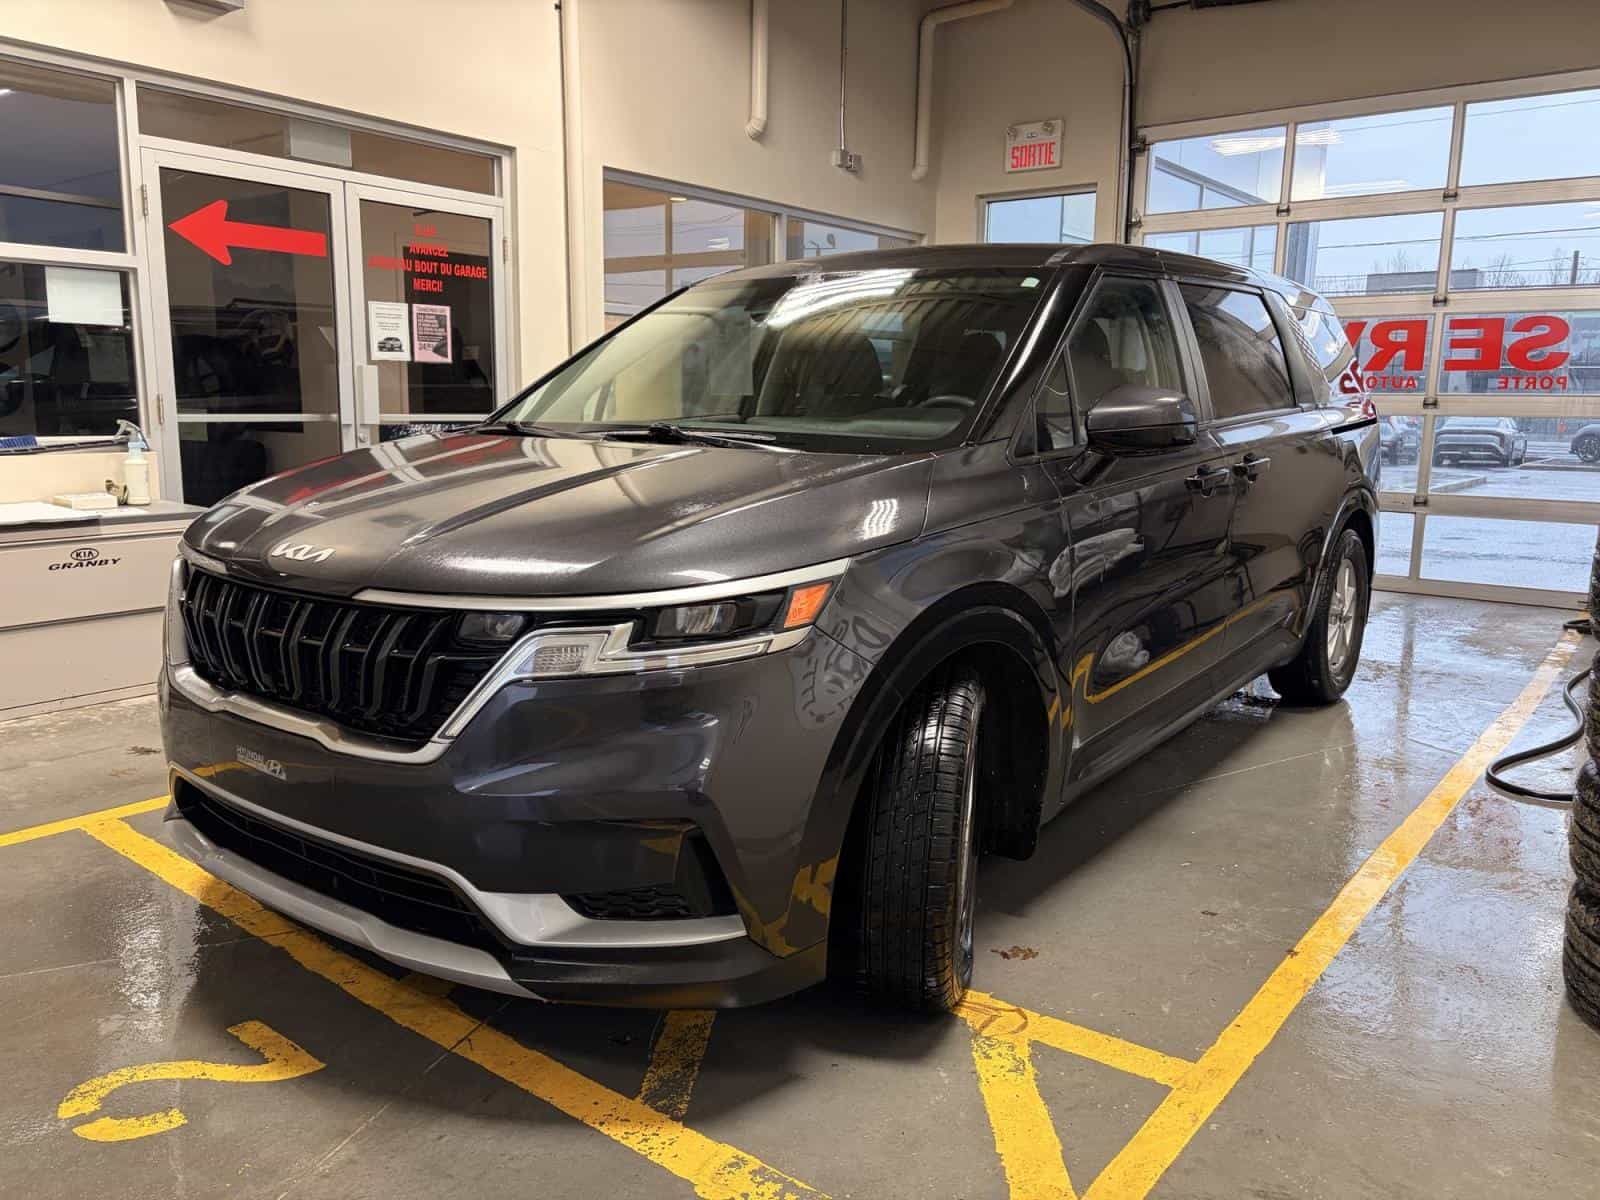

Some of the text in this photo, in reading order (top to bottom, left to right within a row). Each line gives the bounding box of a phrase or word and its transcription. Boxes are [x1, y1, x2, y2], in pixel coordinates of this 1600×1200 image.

[1010, 141, 1056, 169] SORTIE
[414, 259, 437, 274] BOUT
[440, 263, 452, 276] DU
[454, 264, 487, 279] GARAGE
[268, 542, 336, 563] KIA
[48, 558, 121, 571] GRANBY
